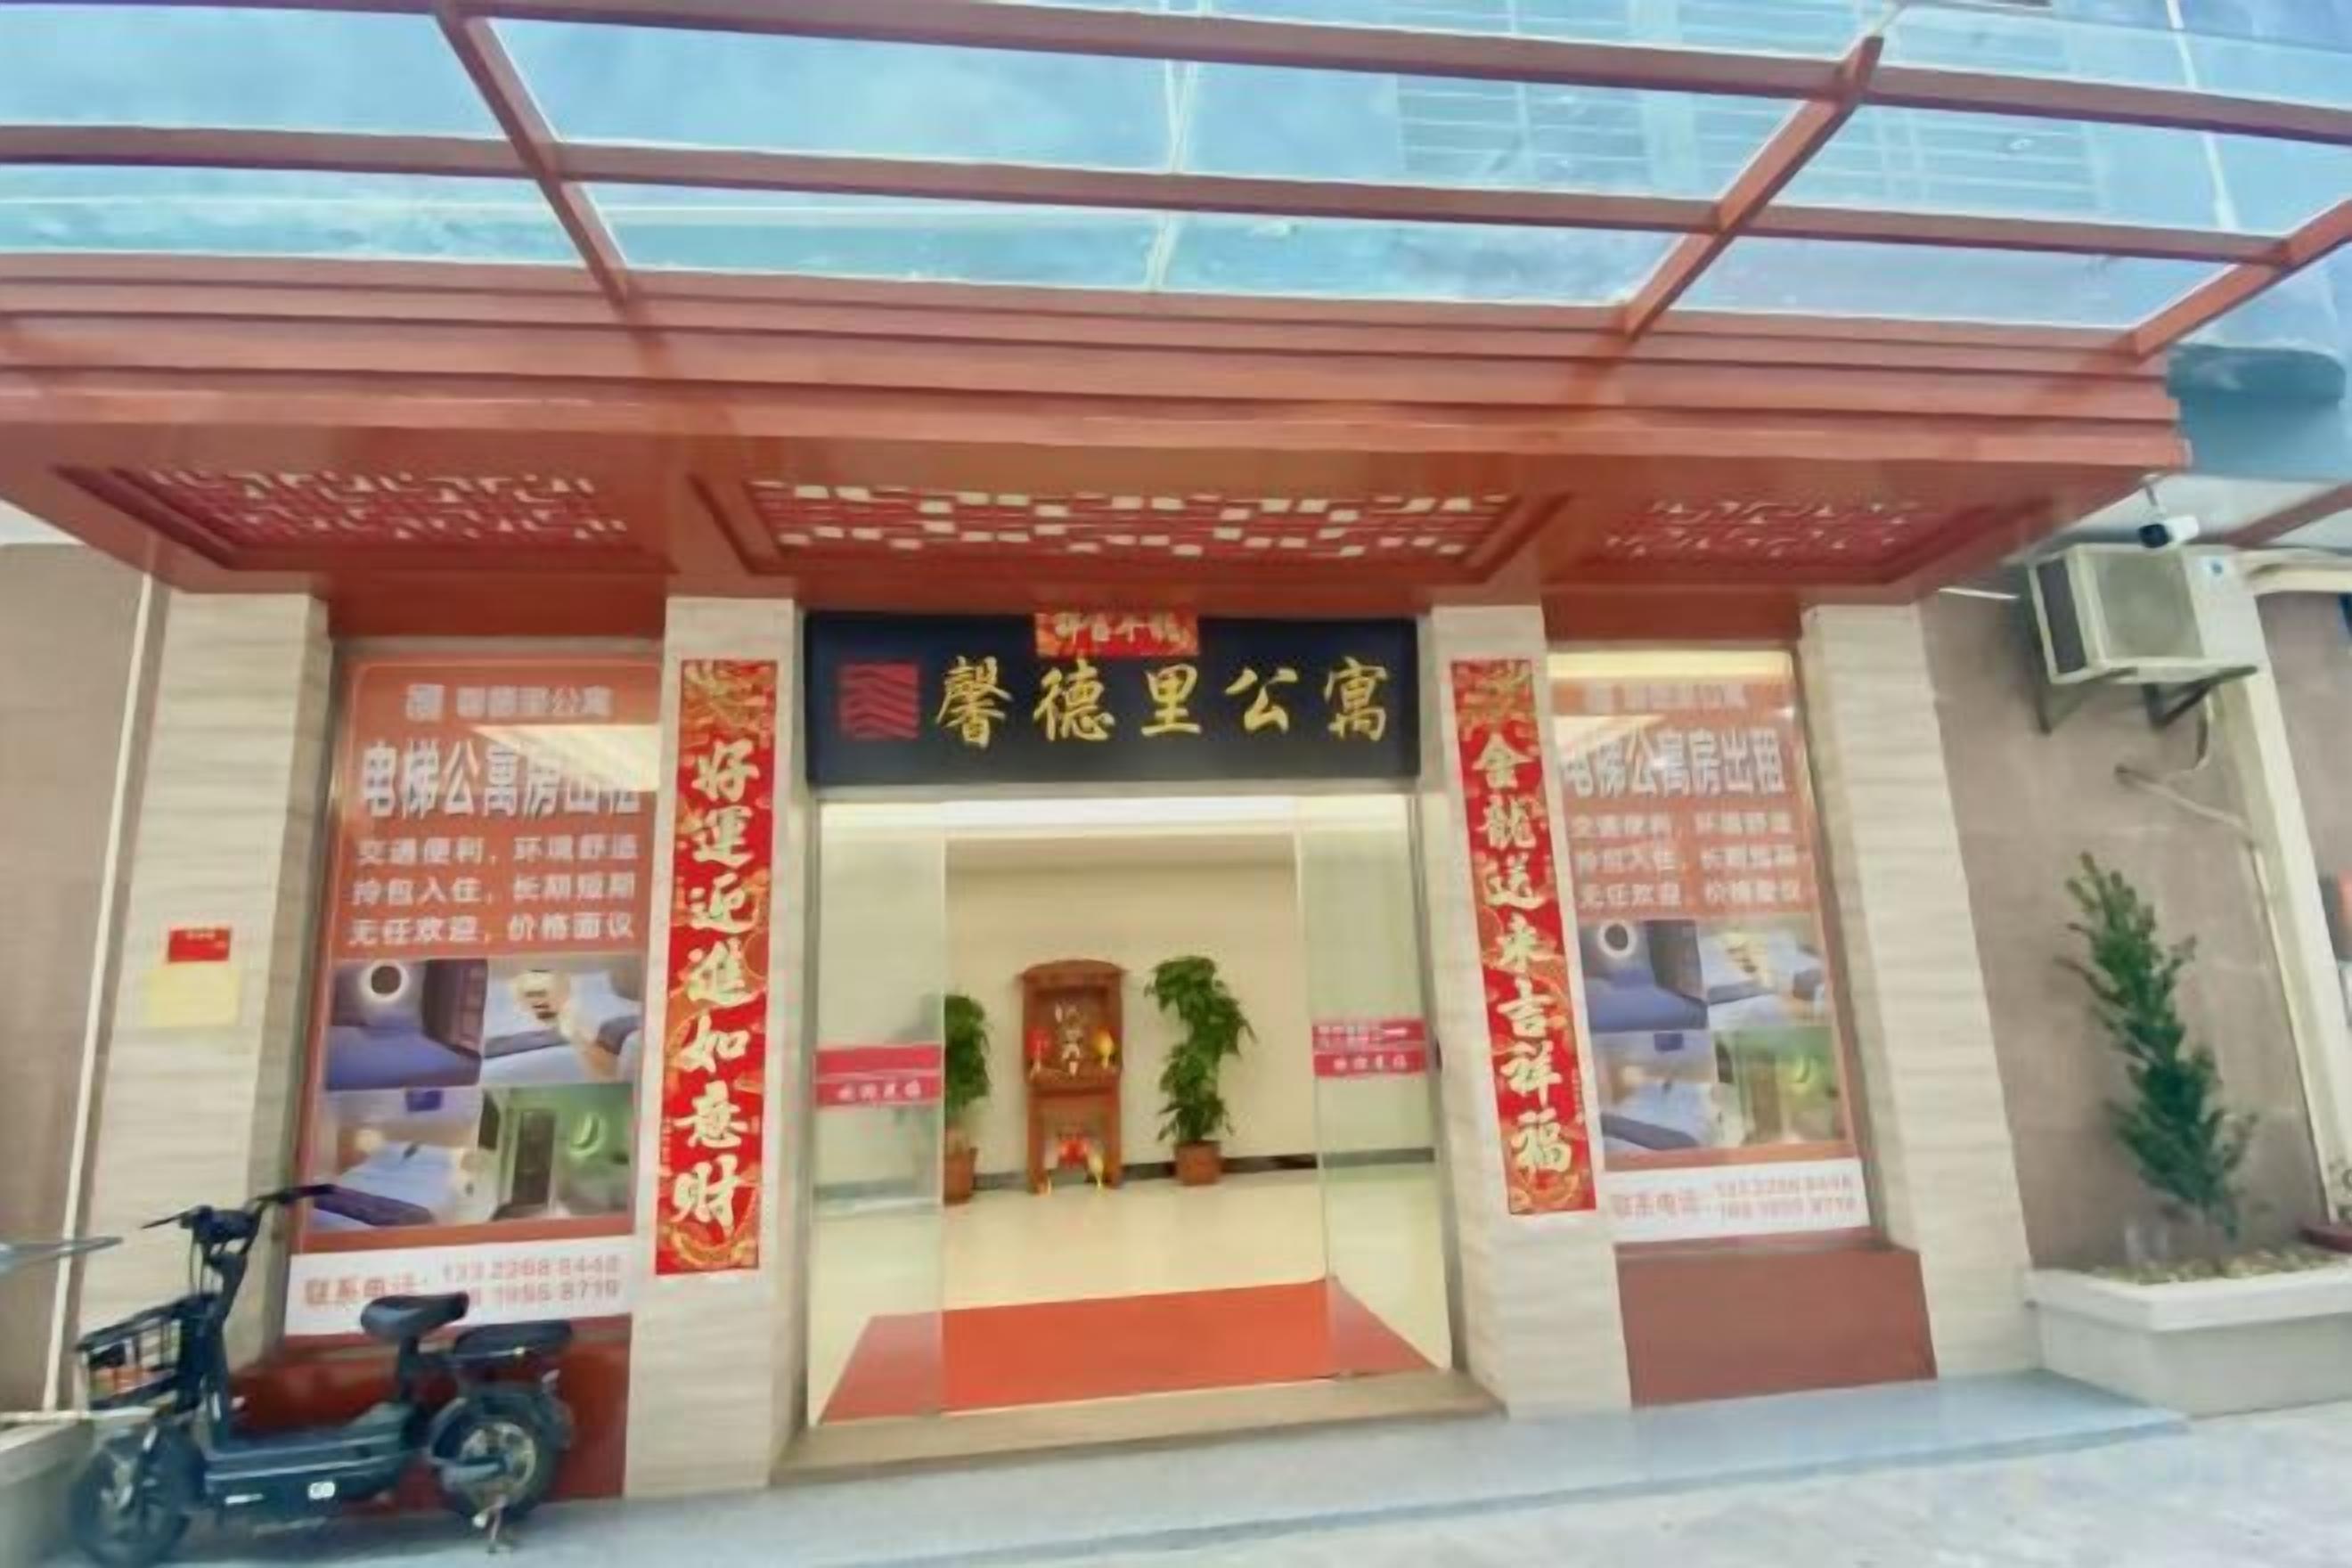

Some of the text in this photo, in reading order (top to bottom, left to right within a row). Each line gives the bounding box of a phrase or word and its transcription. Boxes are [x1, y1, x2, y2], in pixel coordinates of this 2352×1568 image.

[936, 656, 1389, 748] 馨德里公寓
